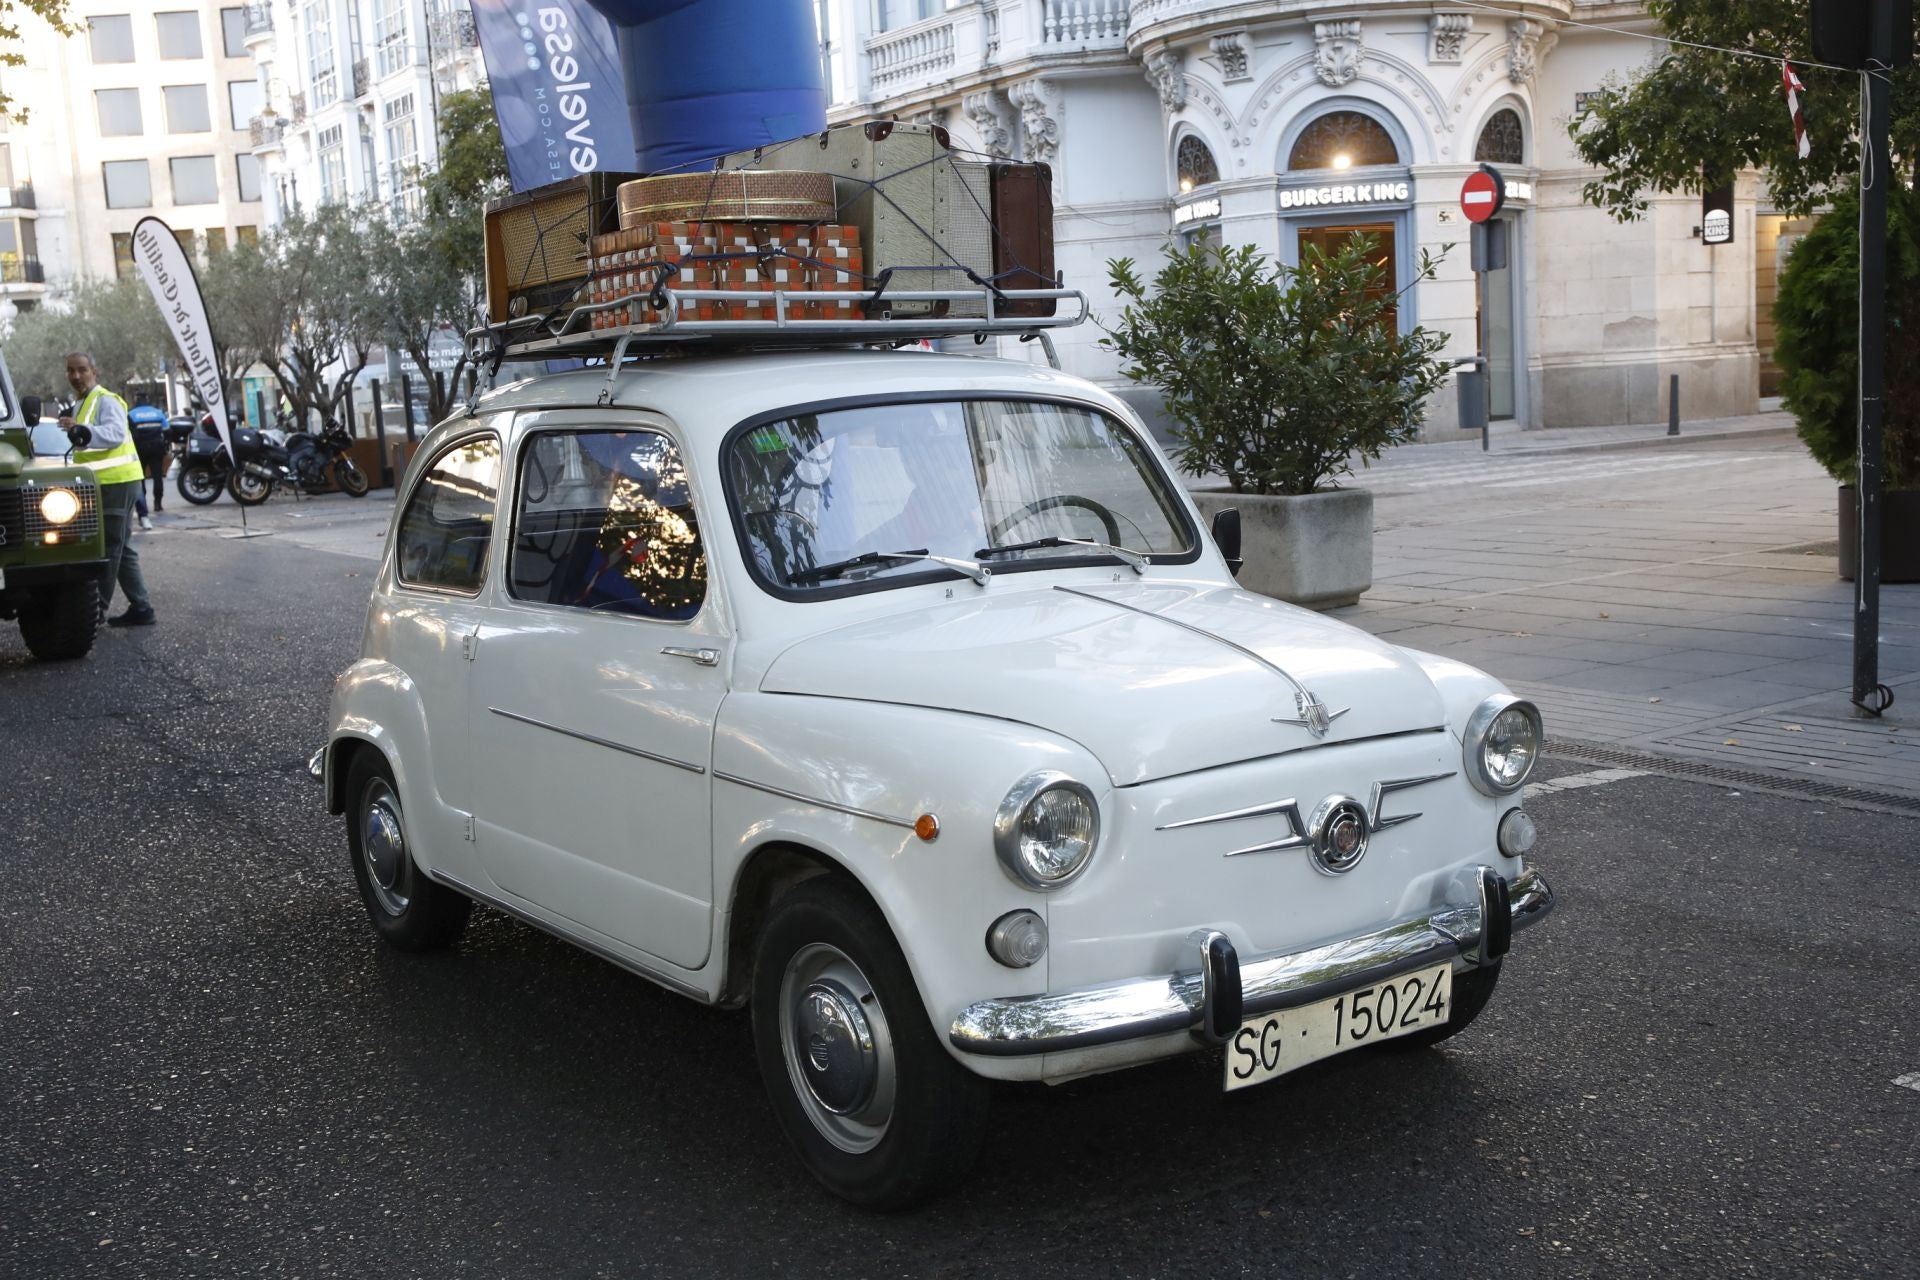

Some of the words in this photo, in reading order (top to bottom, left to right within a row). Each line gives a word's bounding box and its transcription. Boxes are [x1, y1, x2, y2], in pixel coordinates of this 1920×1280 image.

[1280, 185, 1356, 208] BURGER
[1357, 183, 1409, 202] KING
[1192, 199, 1220, 219] KING
[1704, 226, 1730, 236] KING
[1233, 1019, 1281, 1079] SG
[1334, 969, 1445, 1046] 15024
